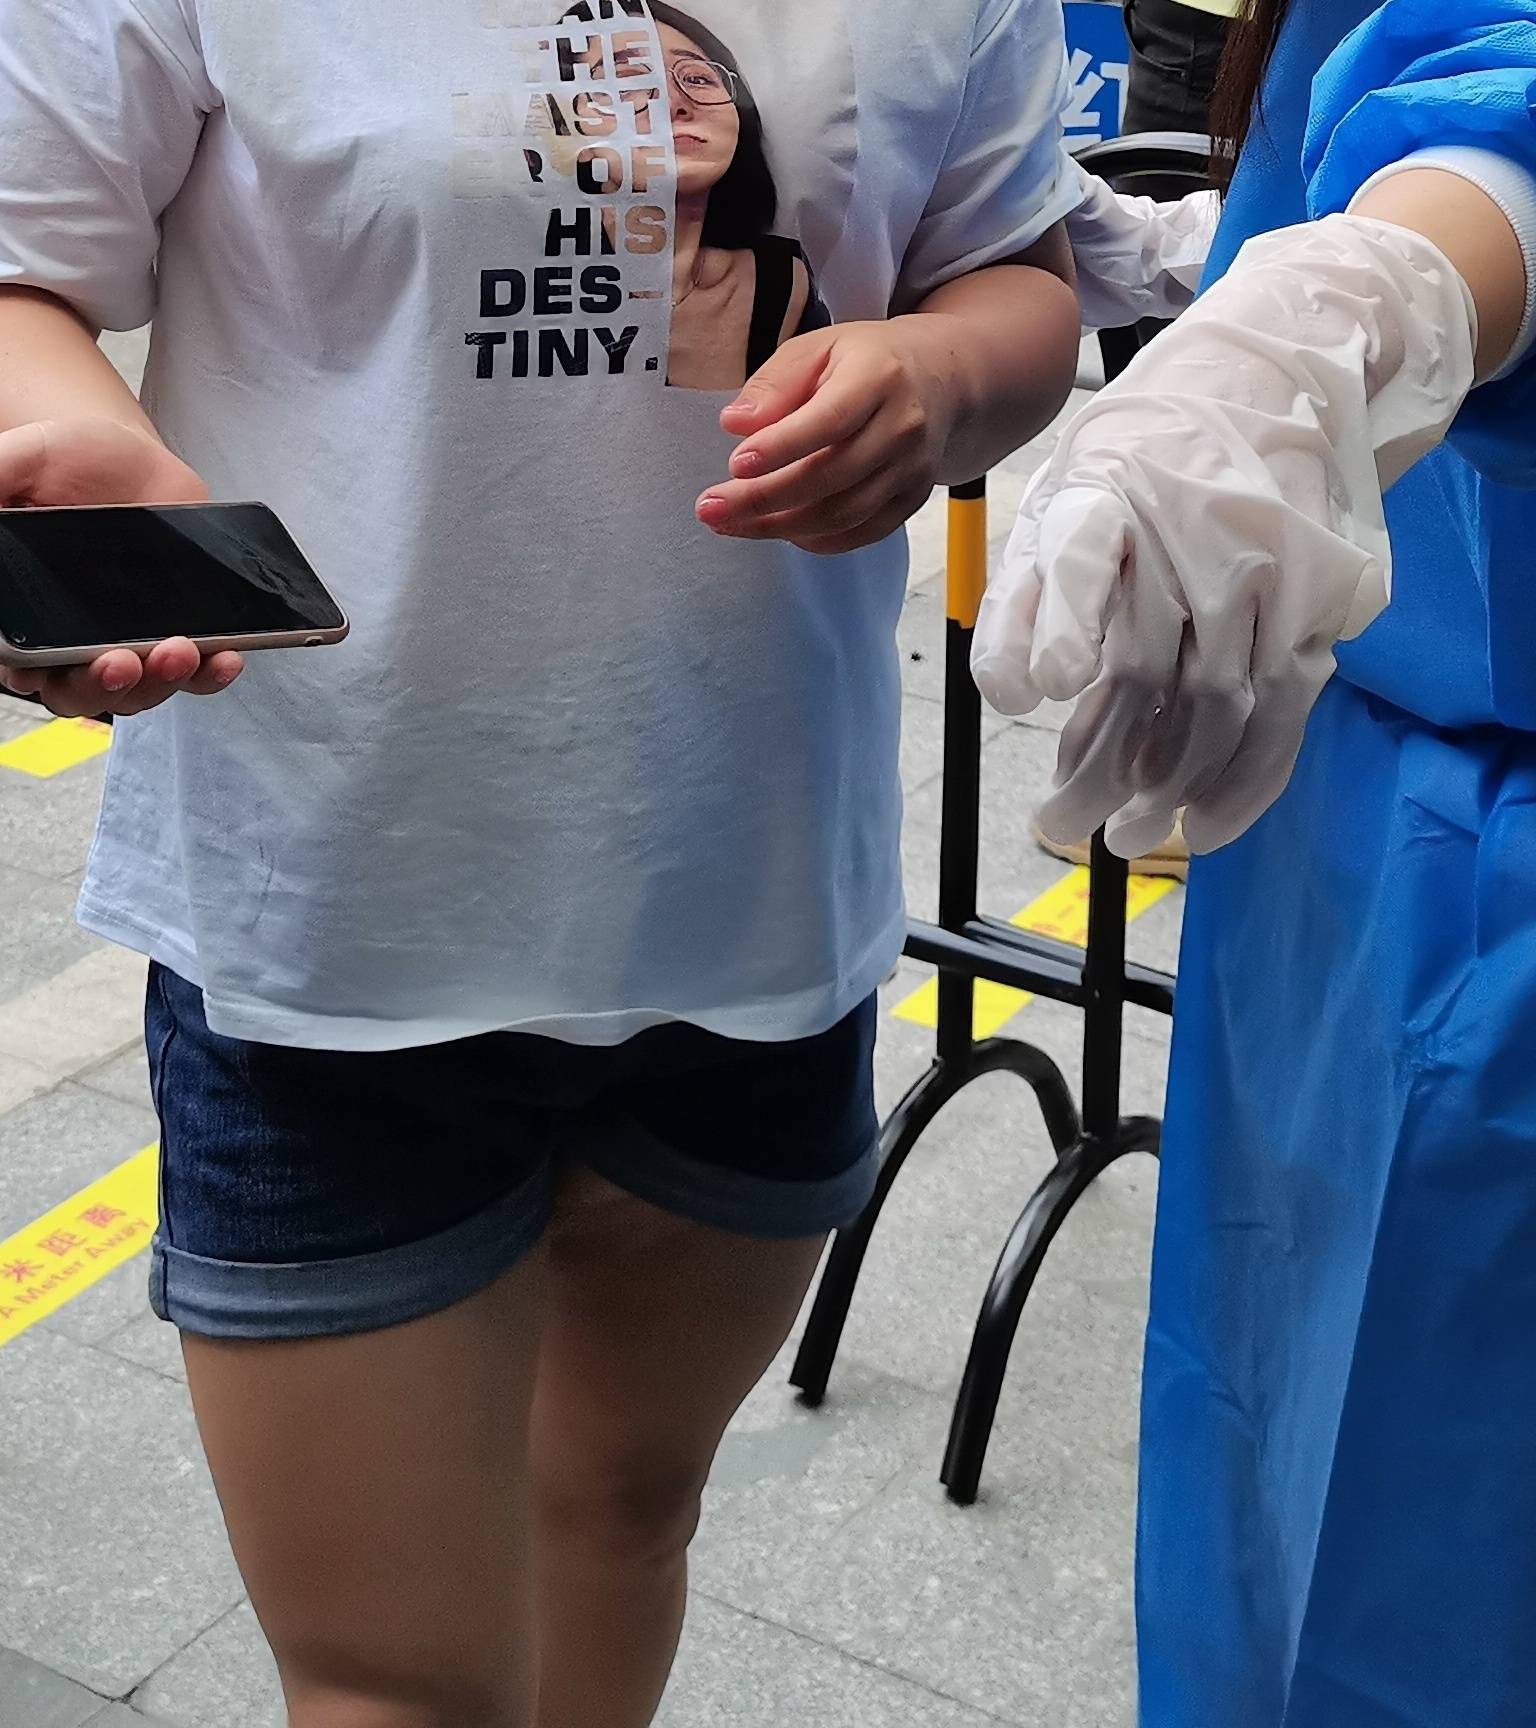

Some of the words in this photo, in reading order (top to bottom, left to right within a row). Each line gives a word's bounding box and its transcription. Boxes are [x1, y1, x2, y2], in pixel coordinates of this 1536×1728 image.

[576, 146, 668, 195] OF
[544, 205, 668, 257] HIS
[465, 325, 659, 380] TINY.
